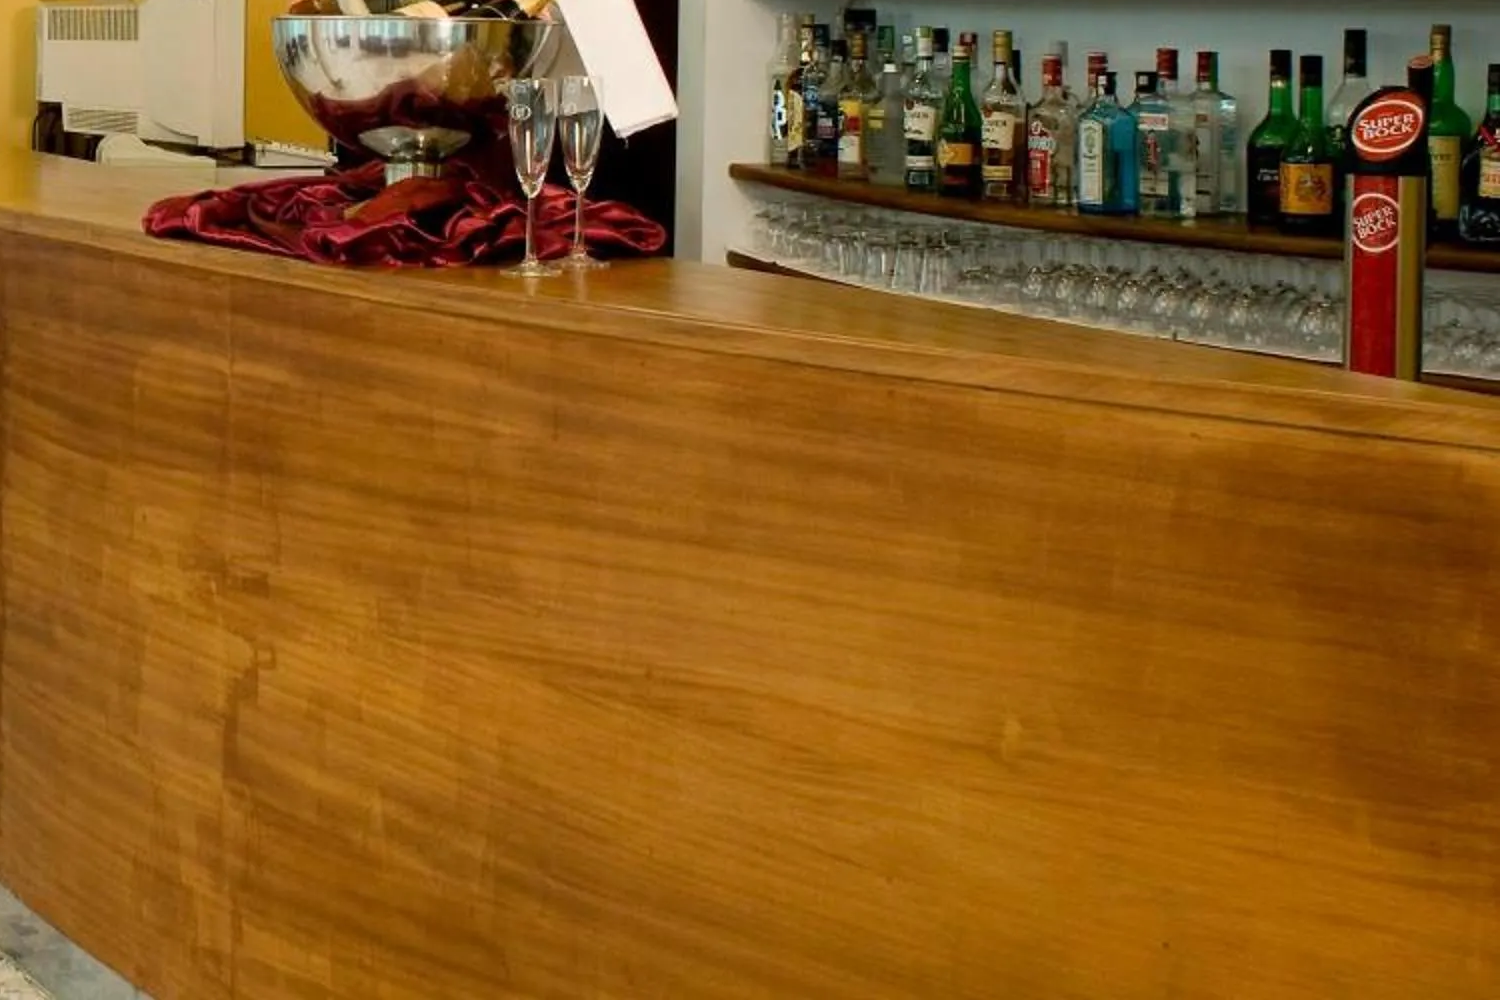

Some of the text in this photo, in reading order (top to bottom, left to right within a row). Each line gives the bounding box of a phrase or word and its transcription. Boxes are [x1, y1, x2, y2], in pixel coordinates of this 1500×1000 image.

[1359, 113, 1415, 130] SUPER
[1363, 123, 1413, 140] BOCK
[1354, 205, 1394, 228] SUPER
[1357, 217, 1396, 239] BOCK
